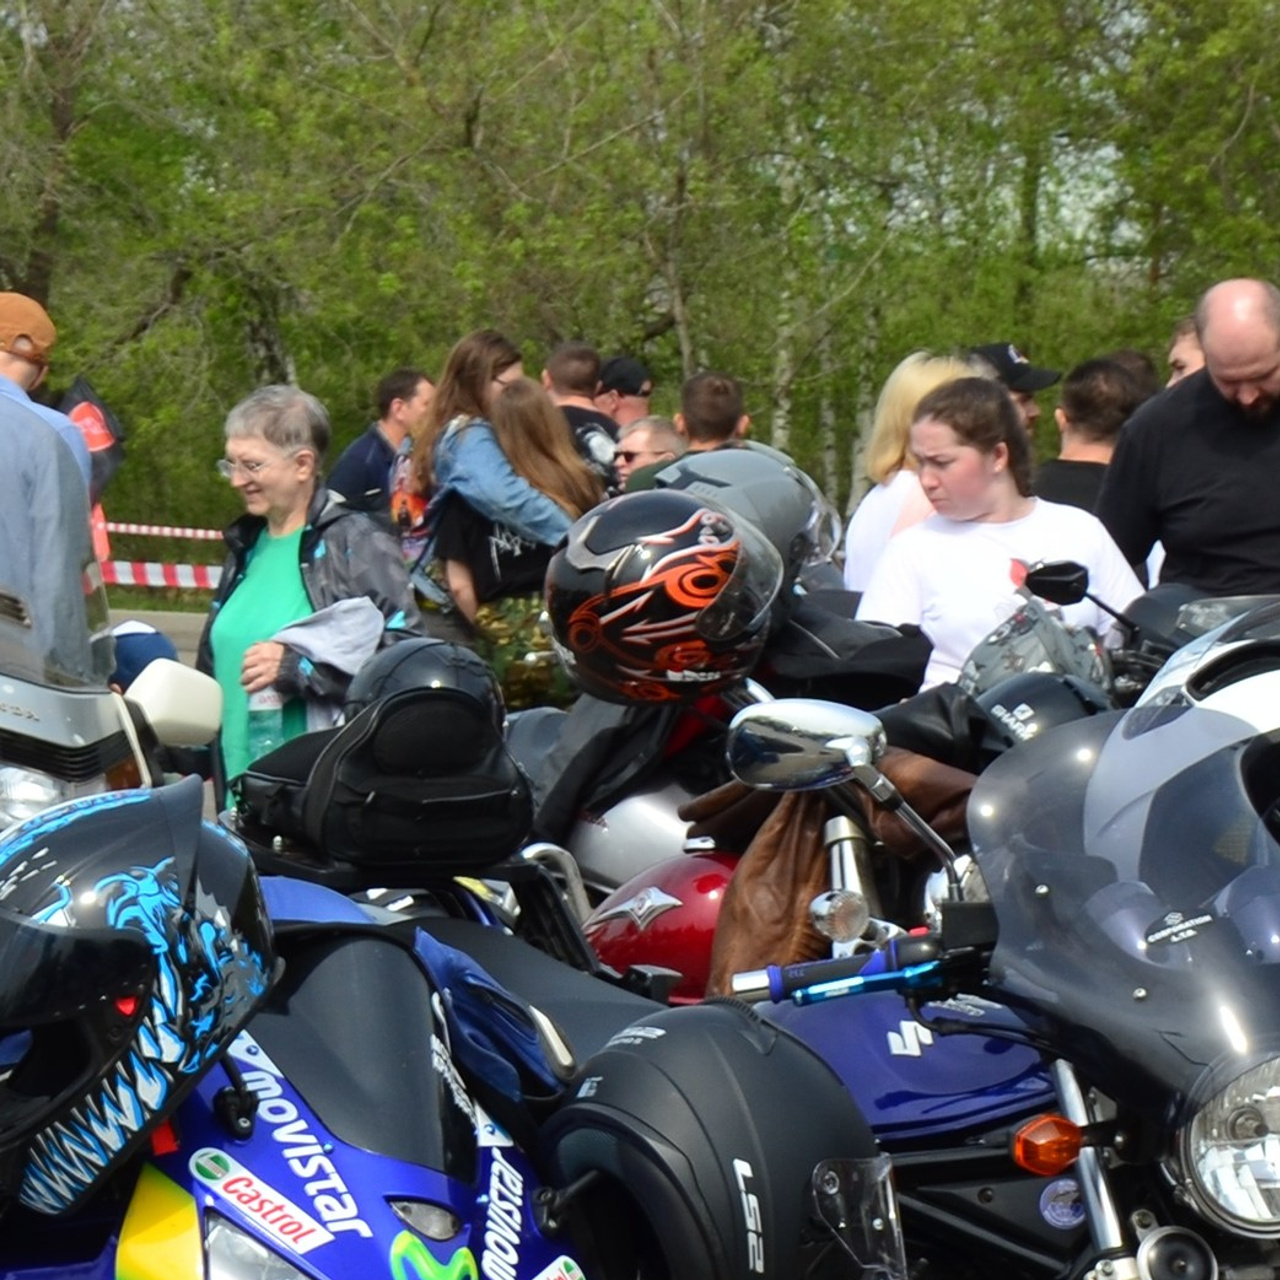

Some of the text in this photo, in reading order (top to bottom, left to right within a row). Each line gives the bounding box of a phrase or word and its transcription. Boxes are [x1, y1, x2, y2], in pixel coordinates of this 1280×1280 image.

[222, 1175, 317, 1245] Castrol
[241, 1070, 374, 1239] movistar
[732, 1157, 765, 1273] LS2
